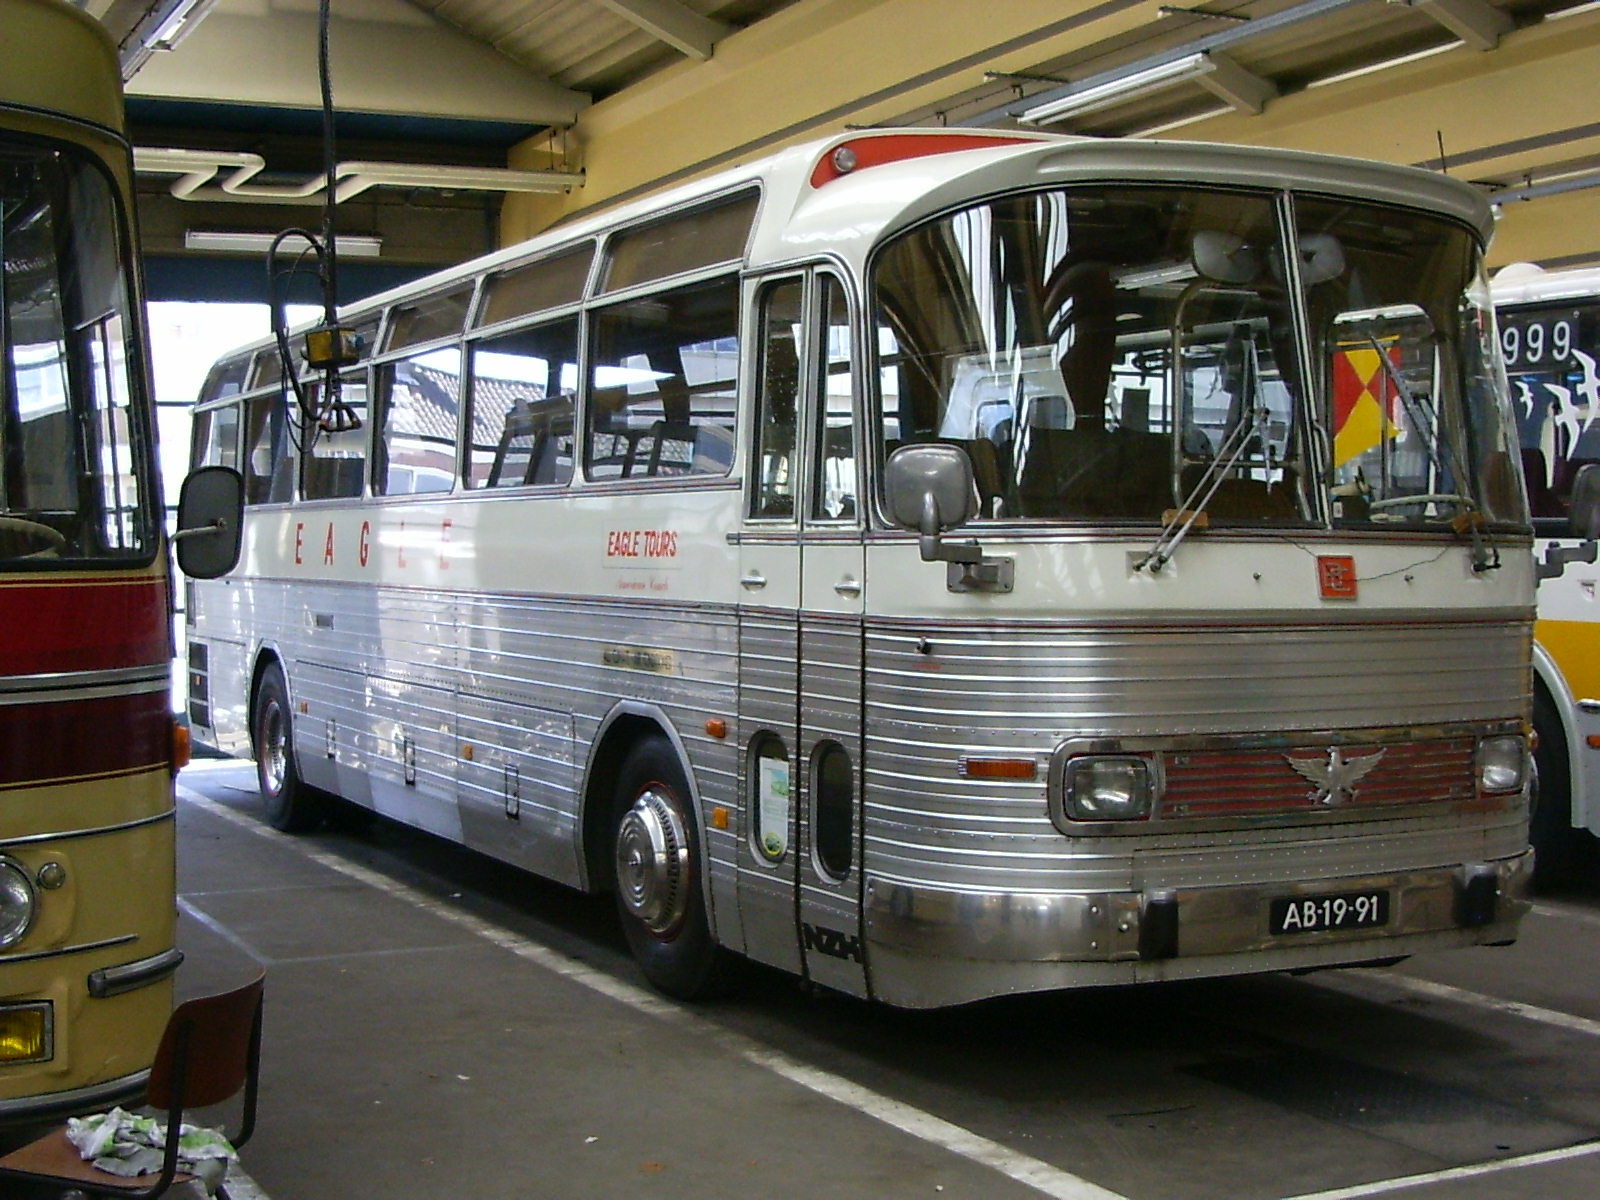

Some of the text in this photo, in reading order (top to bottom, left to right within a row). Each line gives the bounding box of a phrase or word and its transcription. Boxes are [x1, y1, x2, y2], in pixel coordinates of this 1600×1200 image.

[607, 530, 678, 557] EAGLE TOURS
[1282, 895, 1378, 930] AB-19-91
